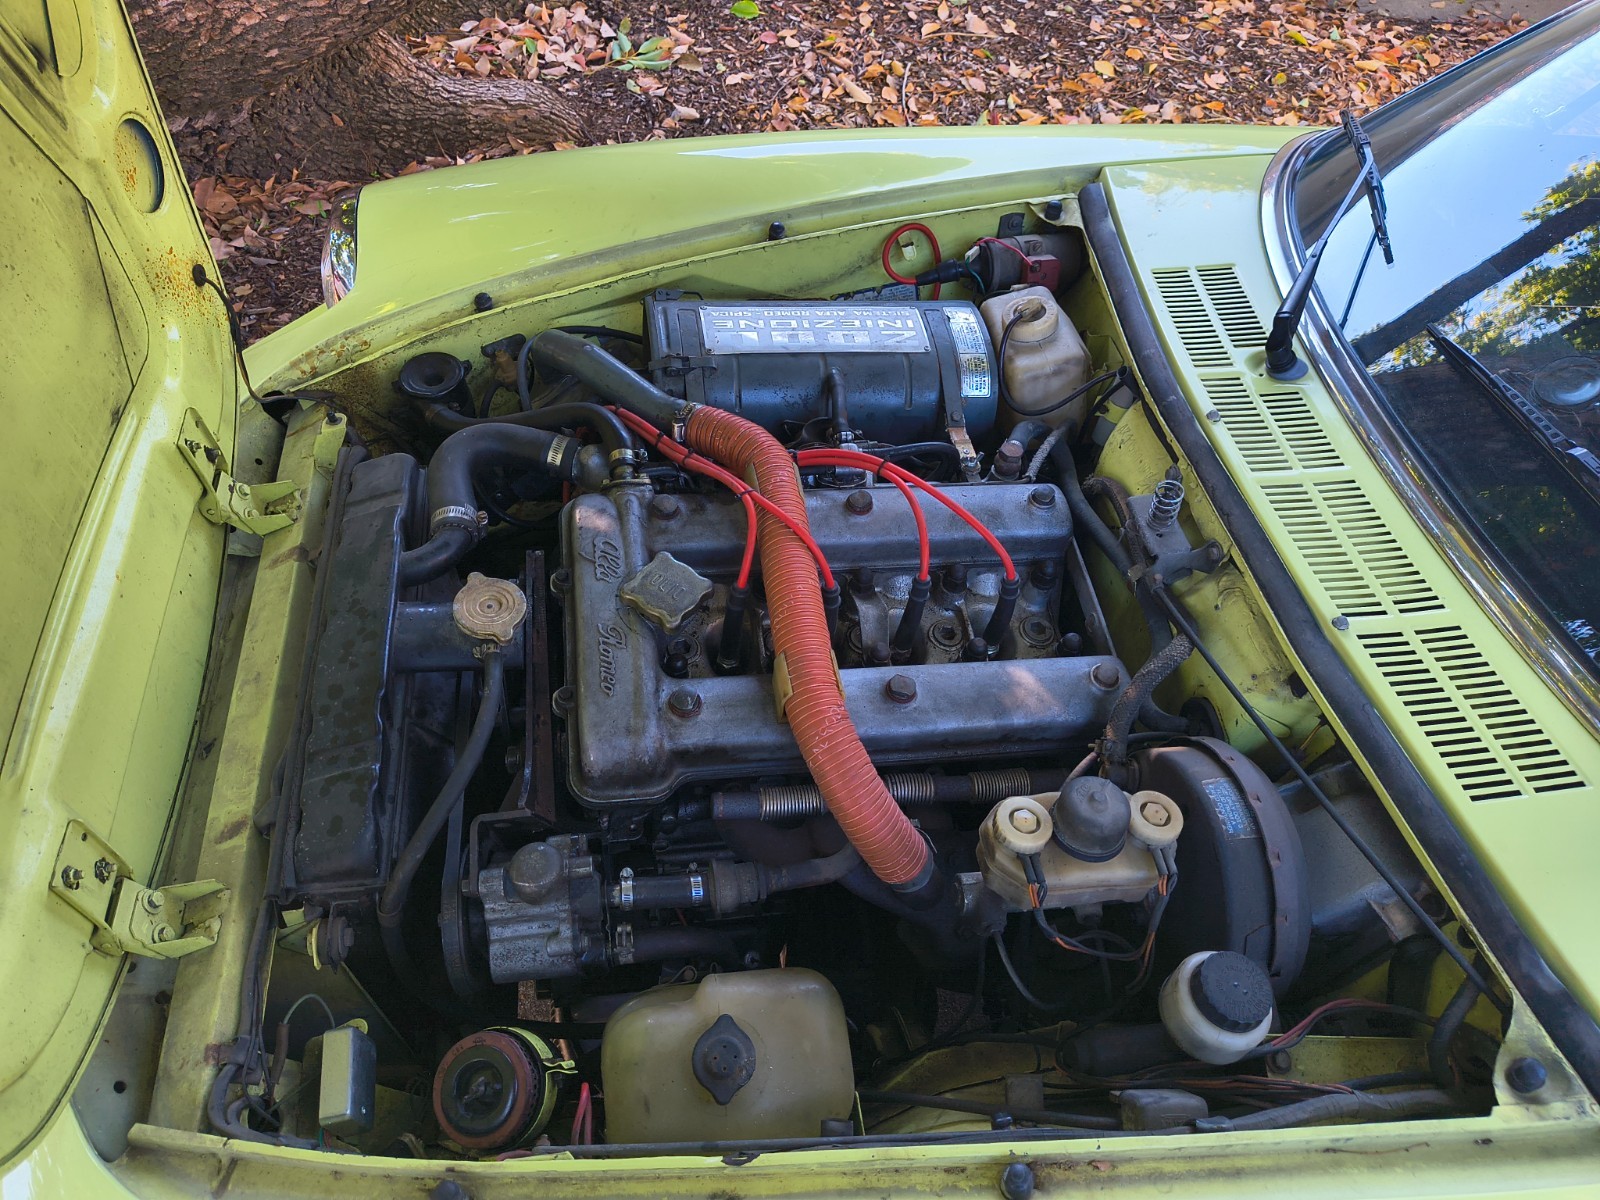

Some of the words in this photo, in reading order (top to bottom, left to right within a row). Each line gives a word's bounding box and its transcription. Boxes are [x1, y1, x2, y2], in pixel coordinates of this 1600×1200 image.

[712, 318, 916, 329] INIEZIONE
[578, 537, 622, 583] Alfa
[597, 623, 627, 697] Romeo
